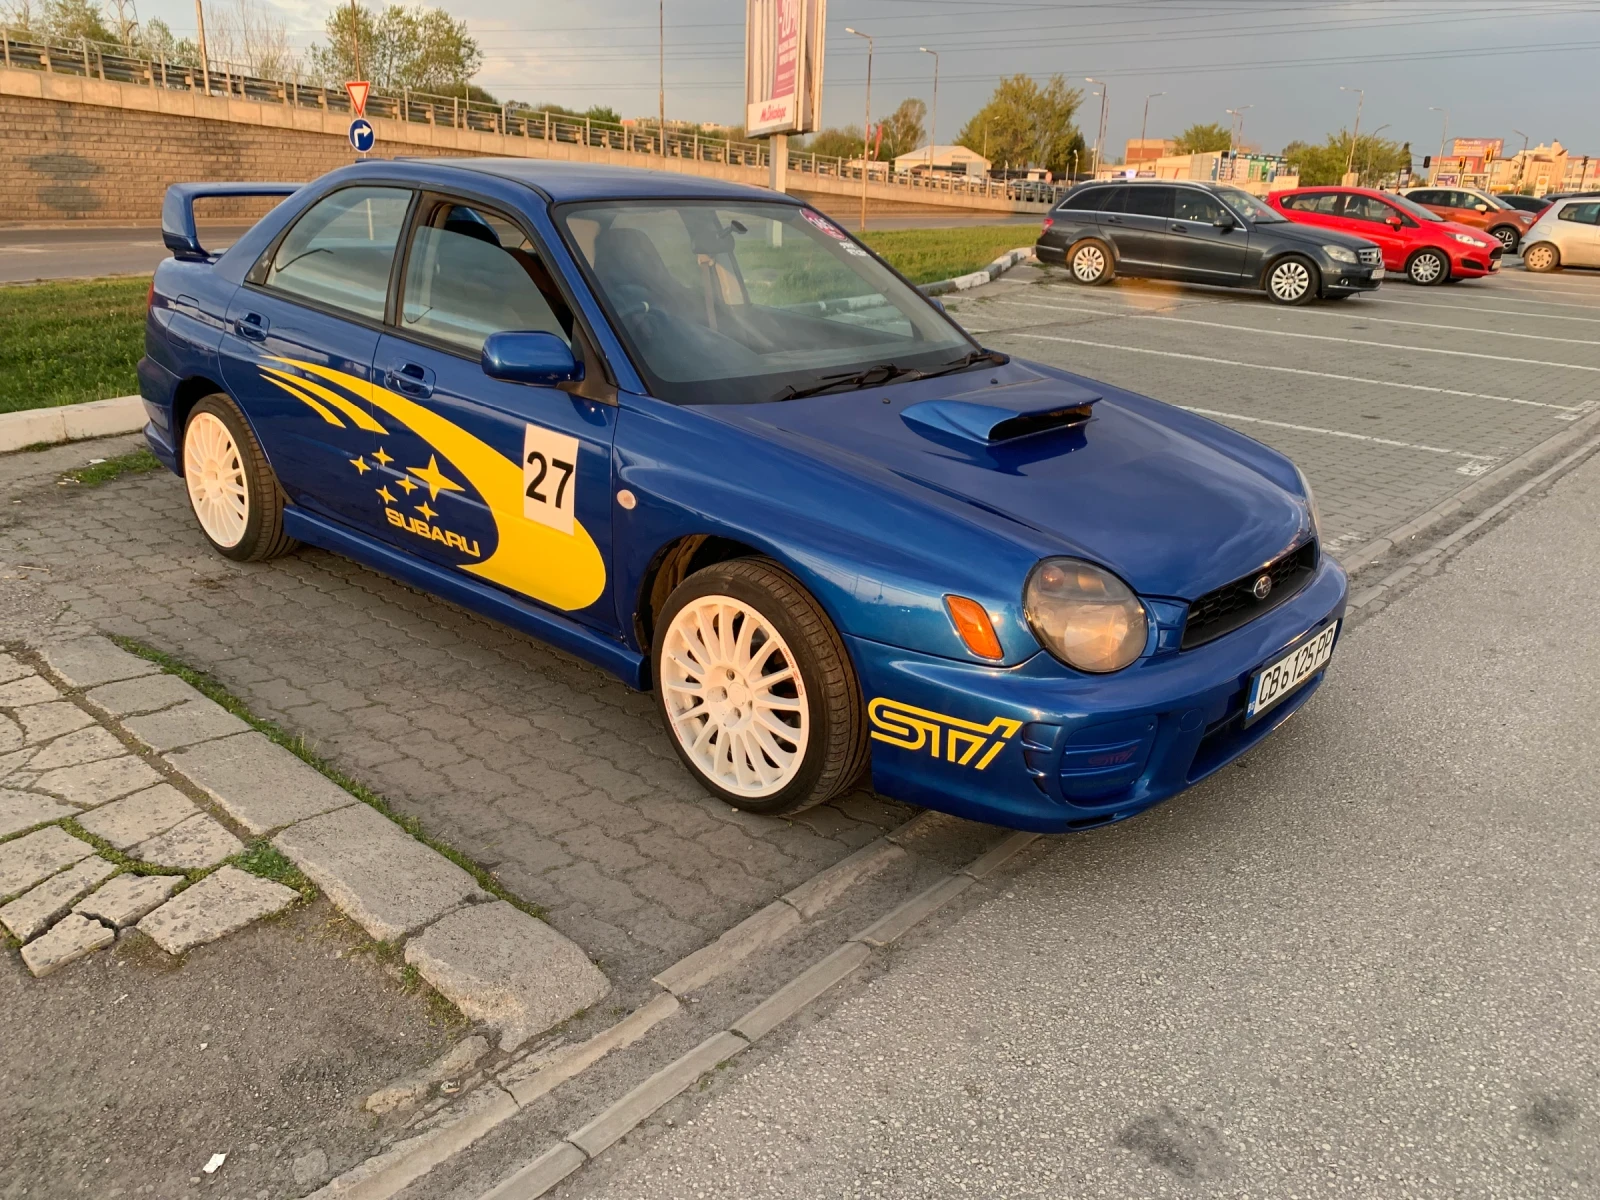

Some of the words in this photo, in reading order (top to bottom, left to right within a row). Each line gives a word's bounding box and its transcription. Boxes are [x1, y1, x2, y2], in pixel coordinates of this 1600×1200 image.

[526, 451, 574, 509] 27
[385, 507, 481, 558] SUBARU
[1259, 666, 1281, 705] CB
[1314, 627, 1334, 666] PP
